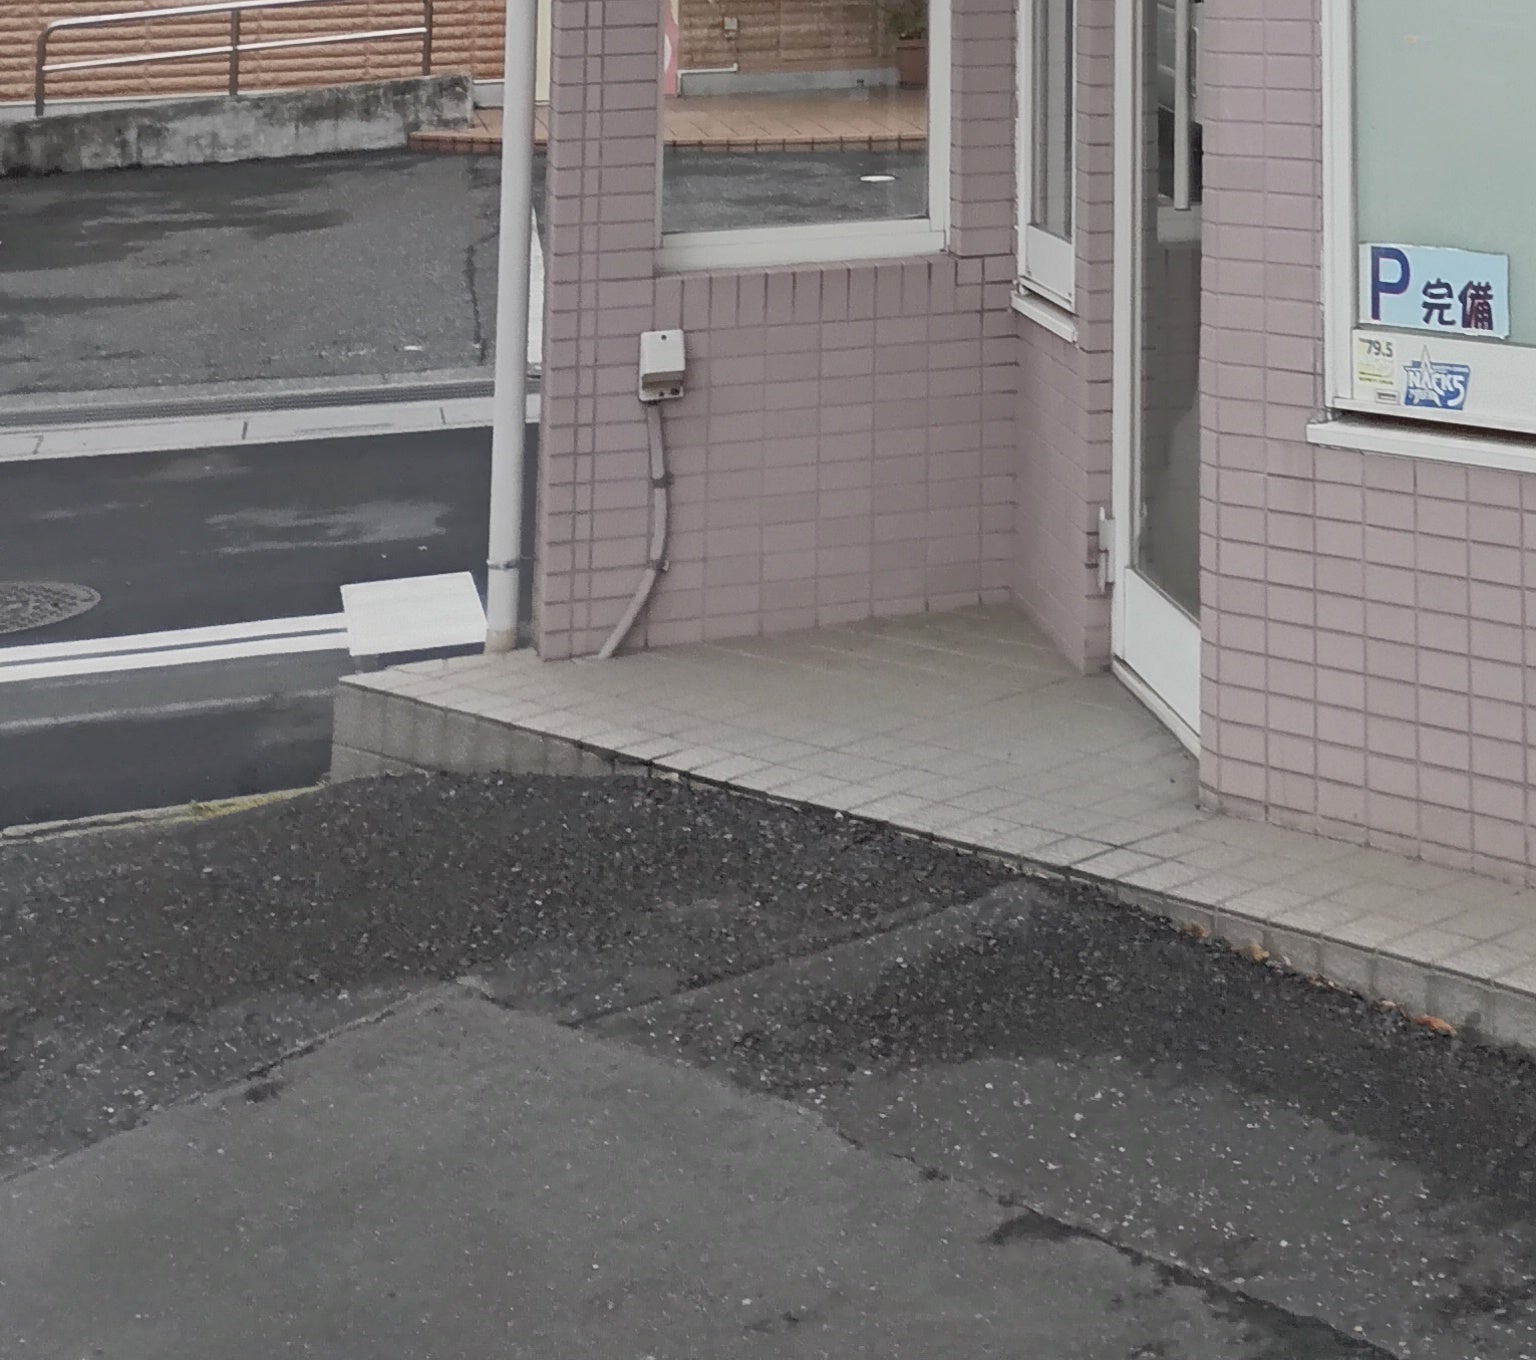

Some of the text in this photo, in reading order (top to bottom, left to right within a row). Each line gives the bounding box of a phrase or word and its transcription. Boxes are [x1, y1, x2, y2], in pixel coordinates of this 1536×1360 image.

[1370, 246, 1494, 330] P 完備
[1359, 337, 1394, 358] 79.5
